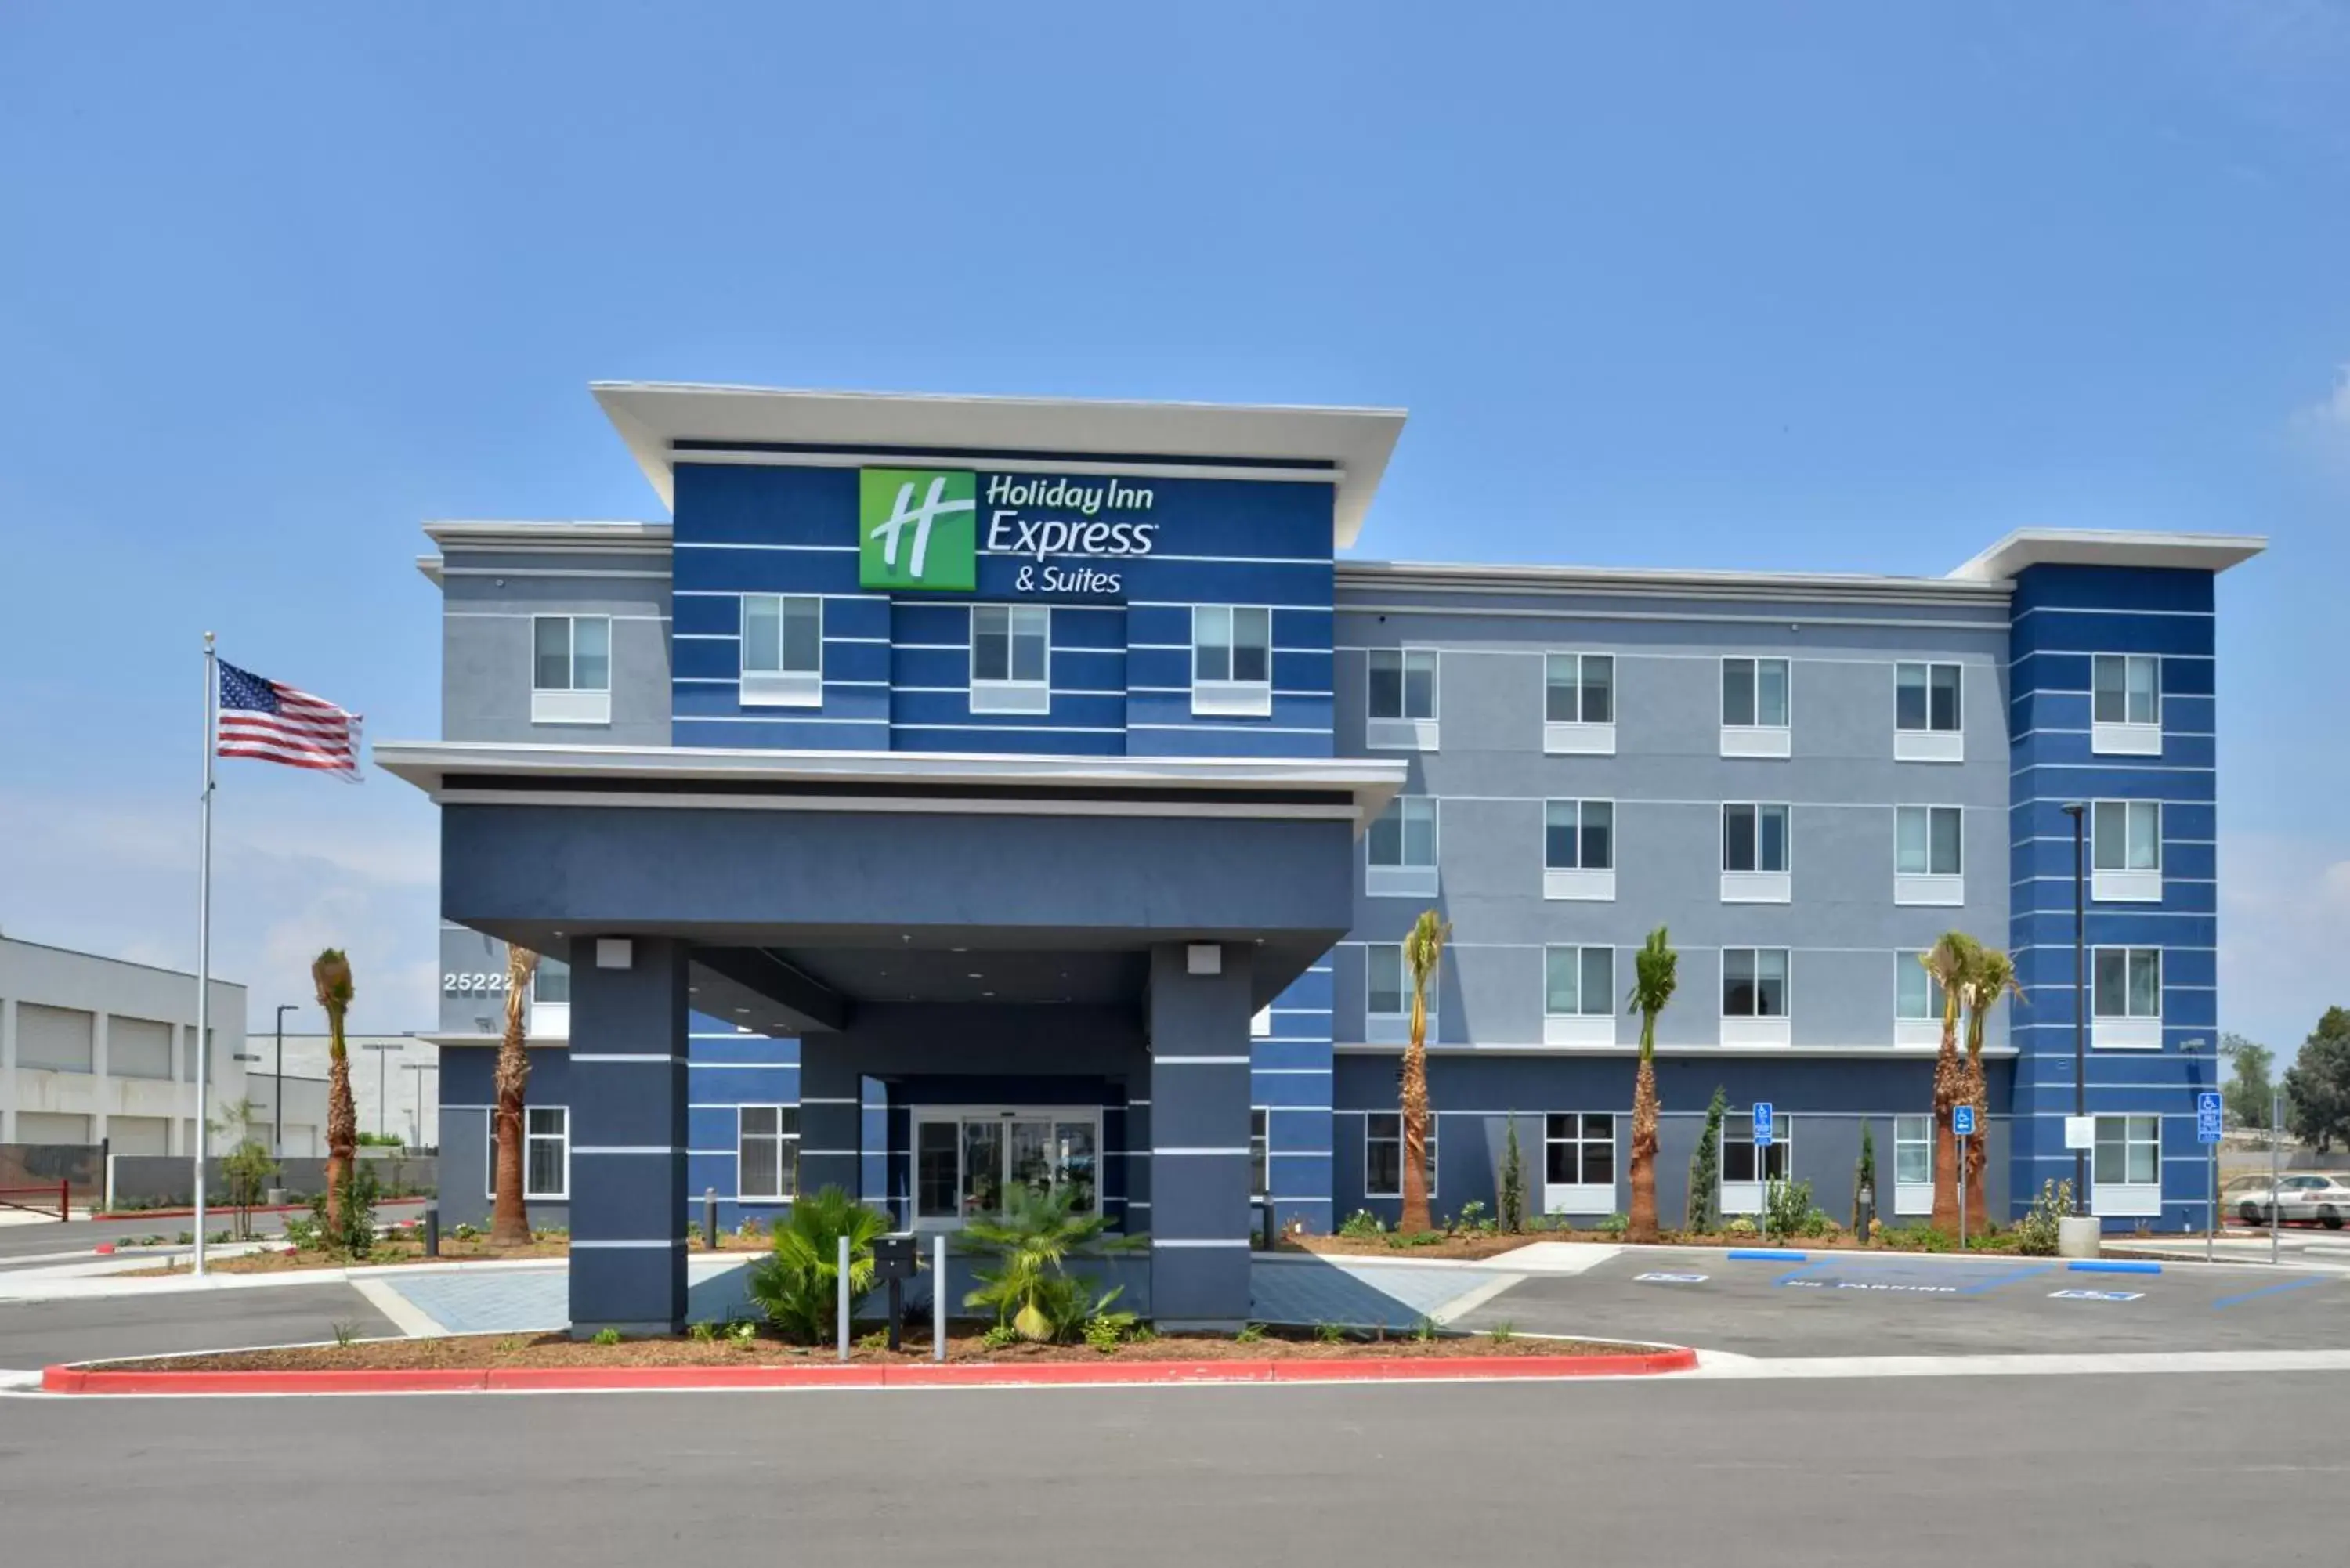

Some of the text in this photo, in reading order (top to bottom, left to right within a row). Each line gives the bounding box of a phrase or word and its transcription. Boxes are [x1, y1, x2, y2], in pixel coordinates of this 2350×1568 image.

[986, 475, 1154, 515] Holiday Inn
[987, 510, 1155, 563] Express
[1015, 565, 1122, 594] & Suites
